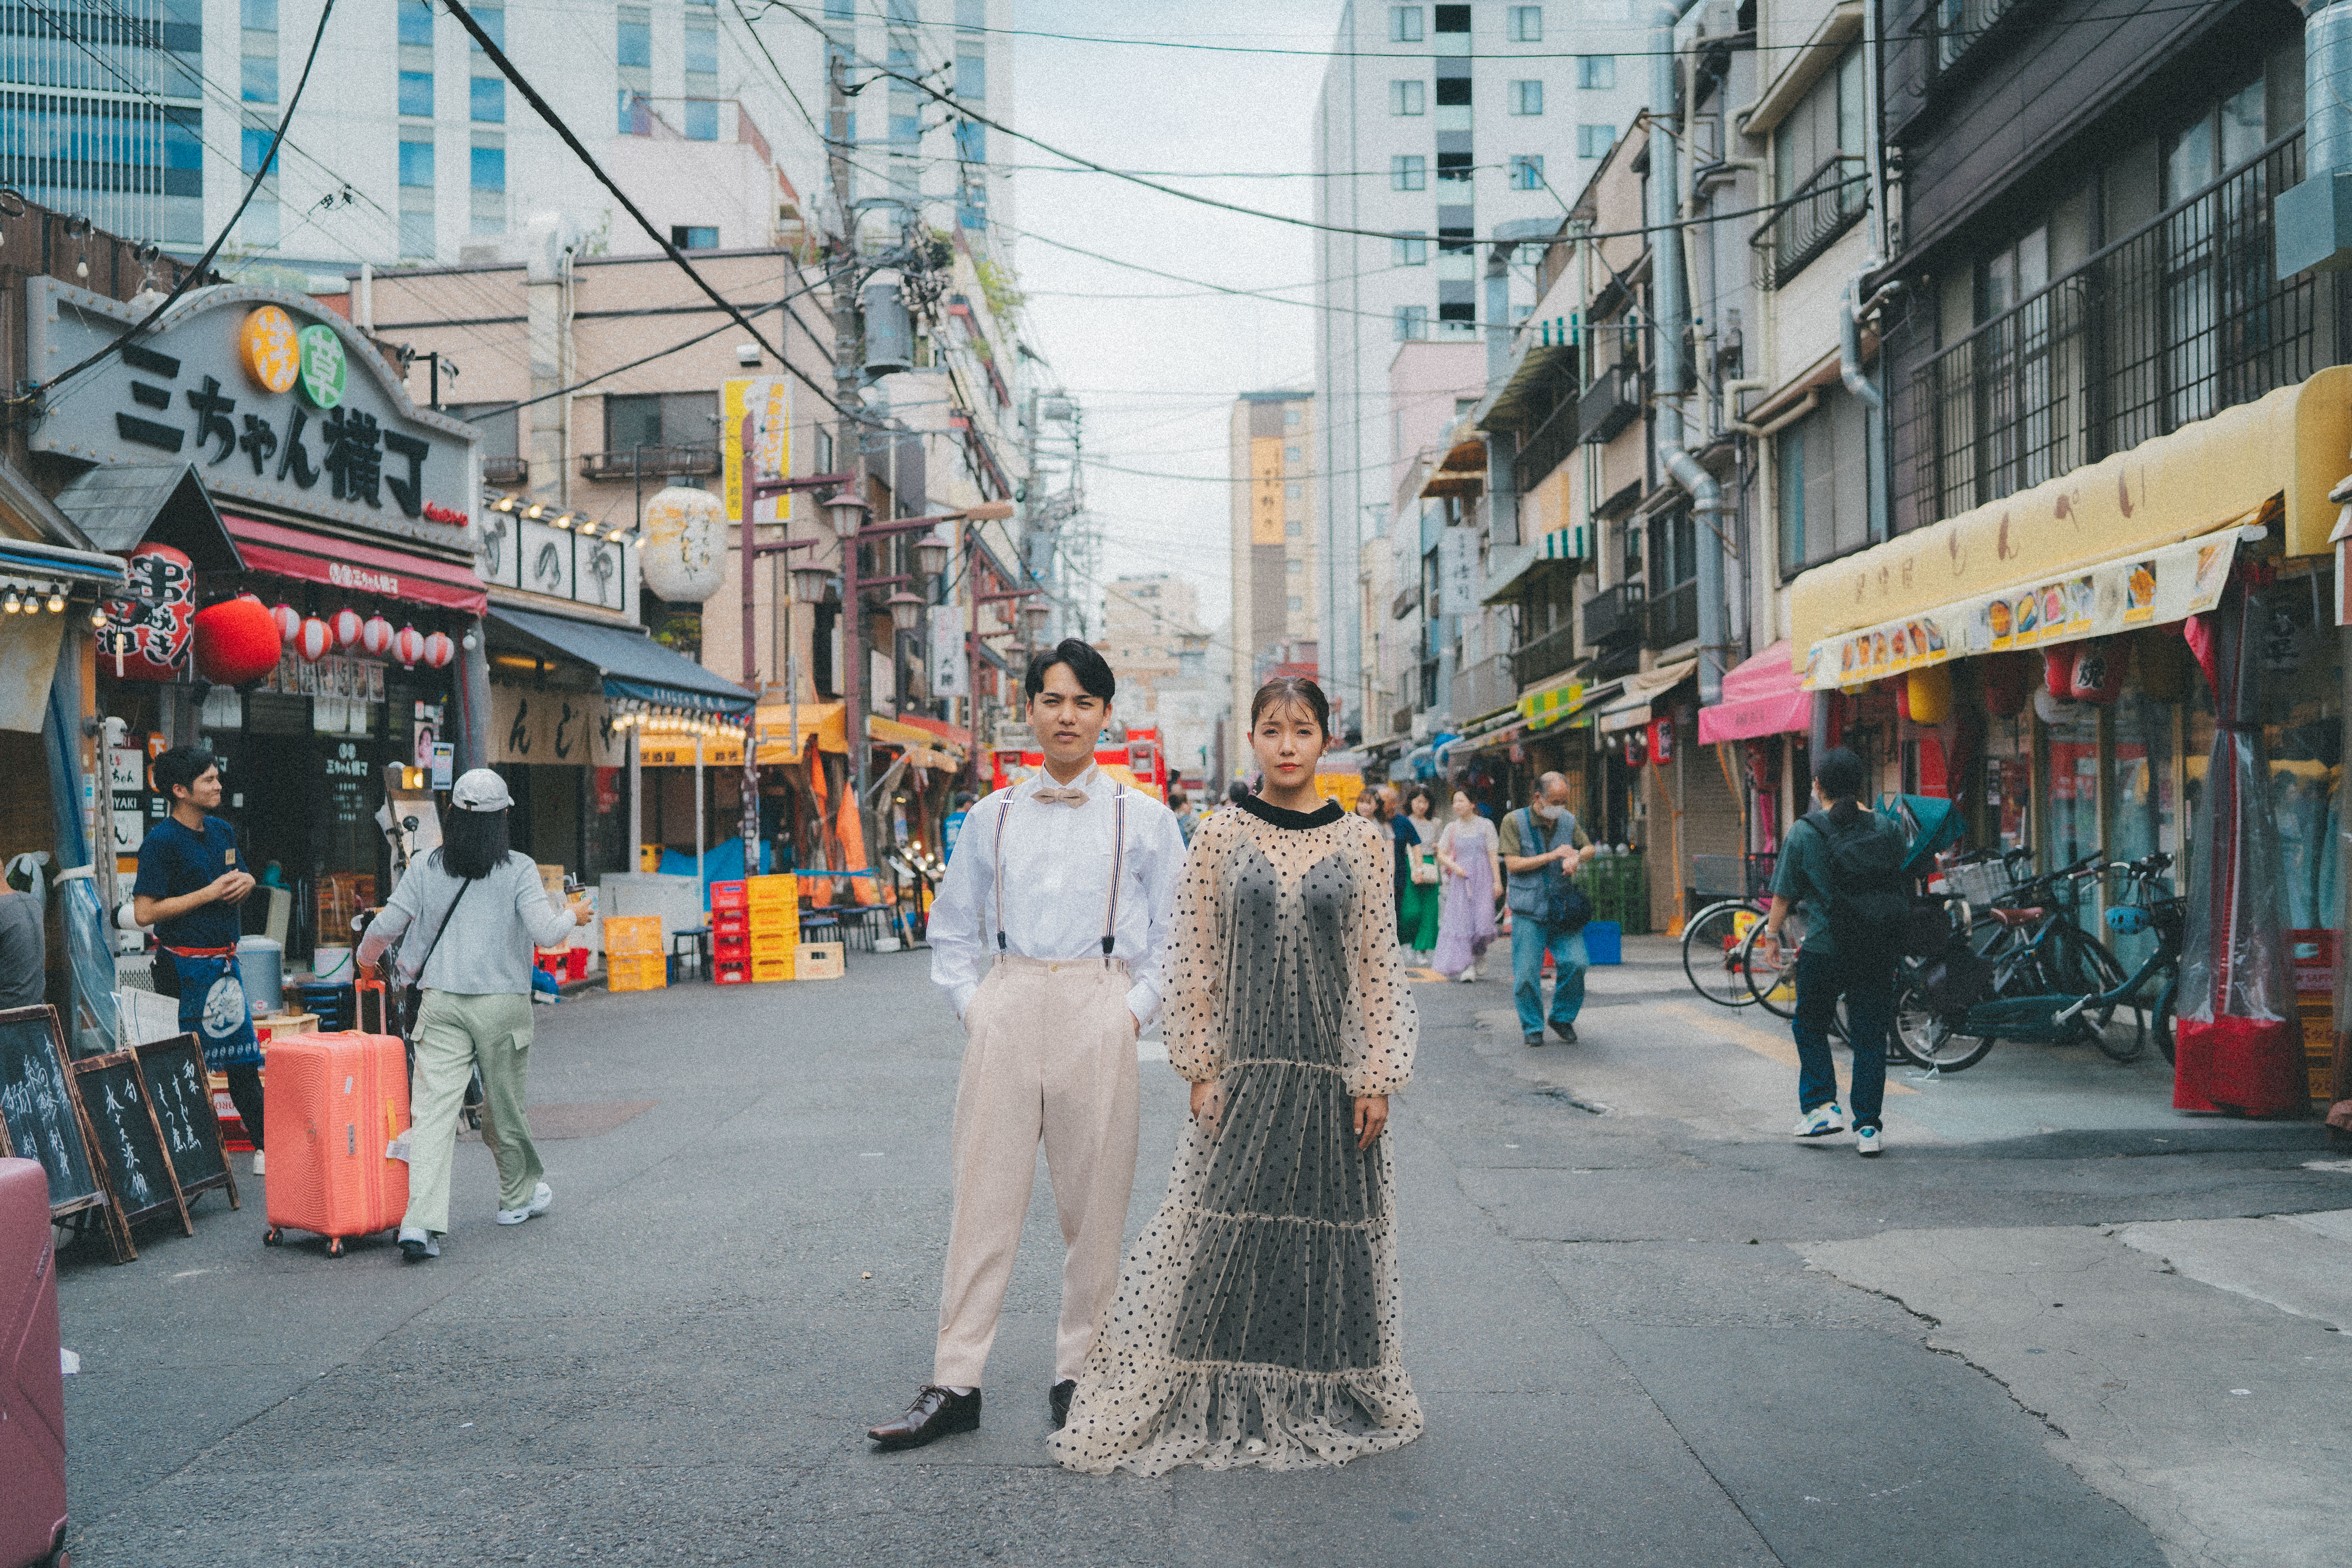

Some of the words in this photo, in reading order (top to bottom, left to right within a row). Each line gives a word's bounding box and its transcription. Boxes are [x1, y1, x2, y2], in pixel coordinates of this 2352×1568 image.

[252, 309, 345, 408] 浅草
[117, 344, 430, 517] 三ちゃん横丁
[112, 797, 137, 808] YAKI
